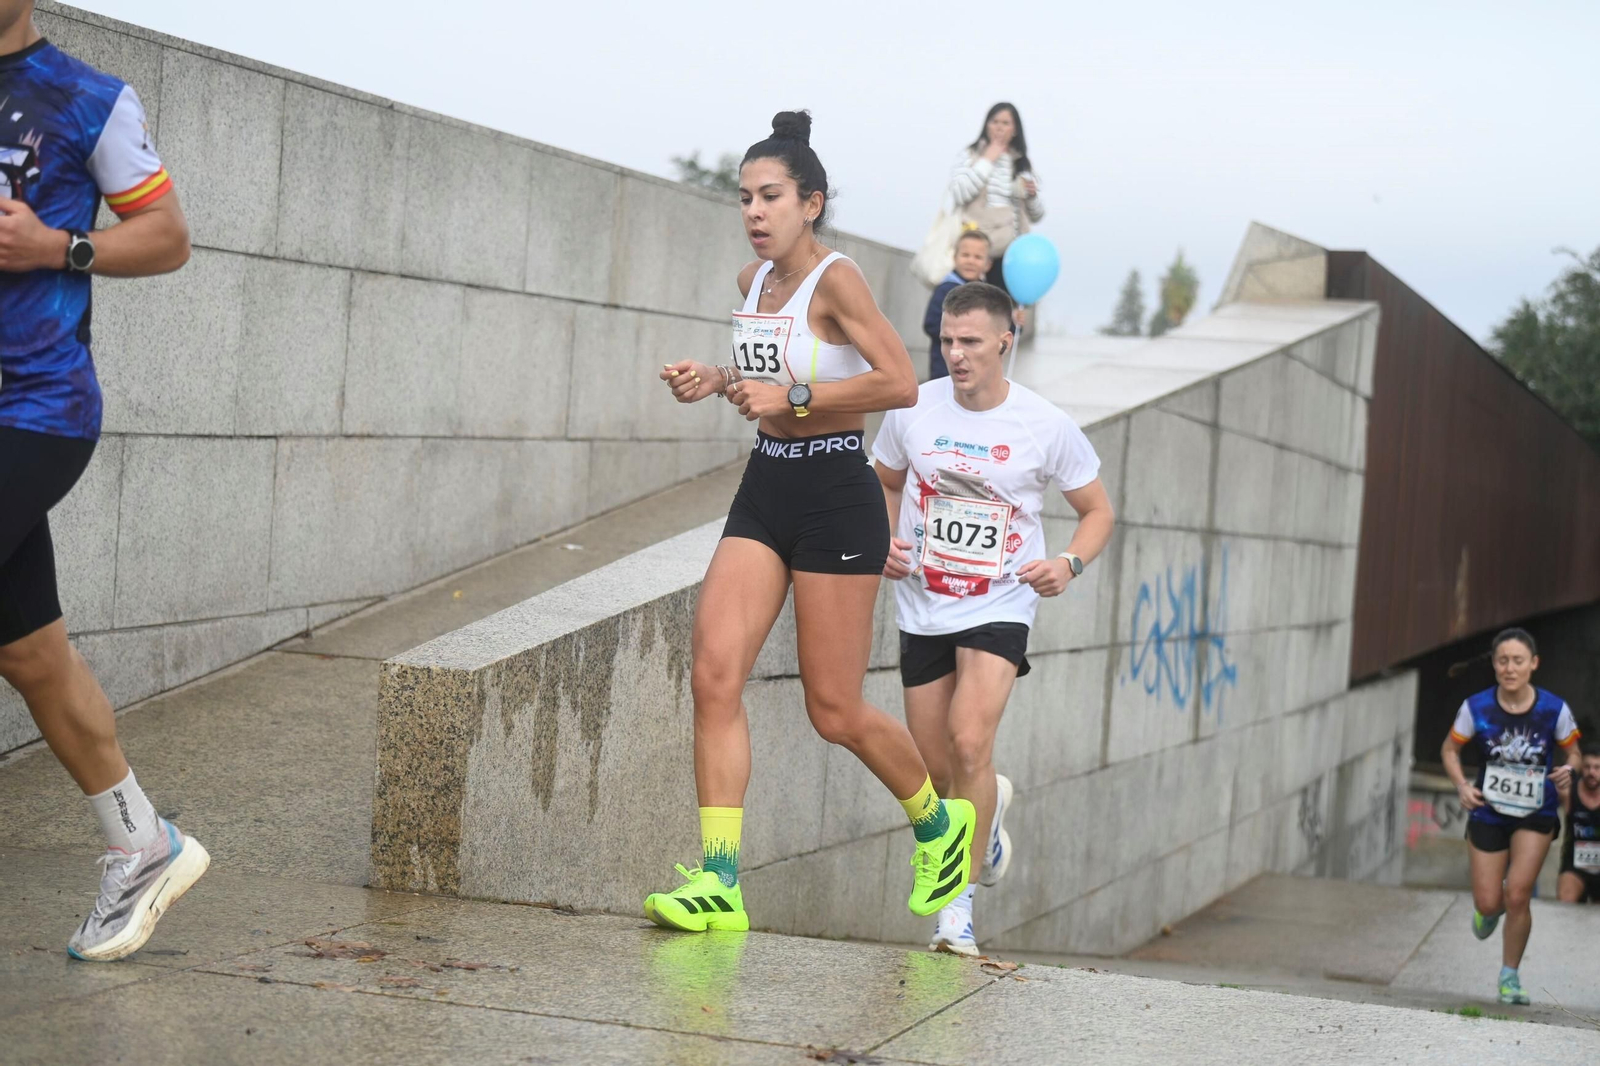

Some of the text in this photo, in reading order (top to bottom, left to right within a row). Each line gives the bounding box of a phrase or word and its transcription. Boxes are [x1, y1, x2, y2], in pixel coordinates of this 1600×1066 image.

[761, 439, 805, 459] NIKE
[808, 435, 860, 456] PRO
[932, 517, 998, 549] 1073
[1488, 775, 1535, 798] 2611
